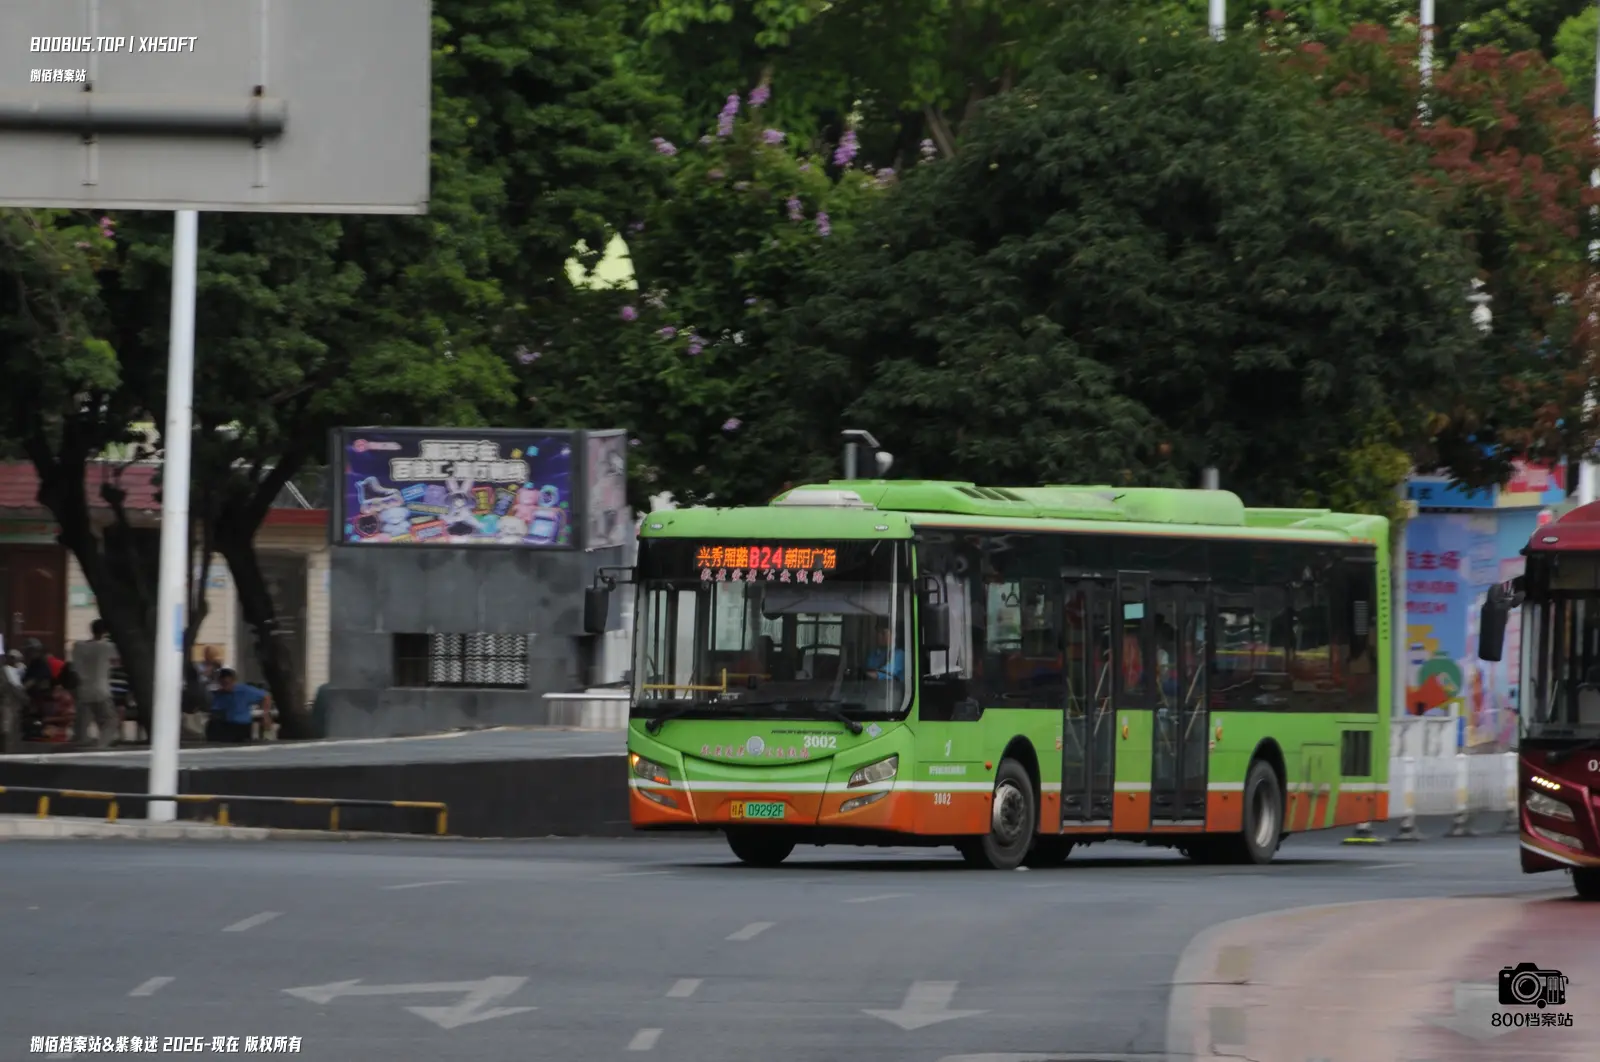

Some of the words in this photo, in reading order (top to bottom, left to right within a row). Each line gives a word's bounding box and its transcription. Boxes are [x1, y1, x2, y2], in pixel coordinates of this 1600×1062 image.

[750, 546, 783, 569] B24
[784, 547, 836, 569] 朝阳广场
[803, 735, 837, 749] 3002
[1587, 759, 1600, 772] 0
[748, 803, 784, 817] 09292F
